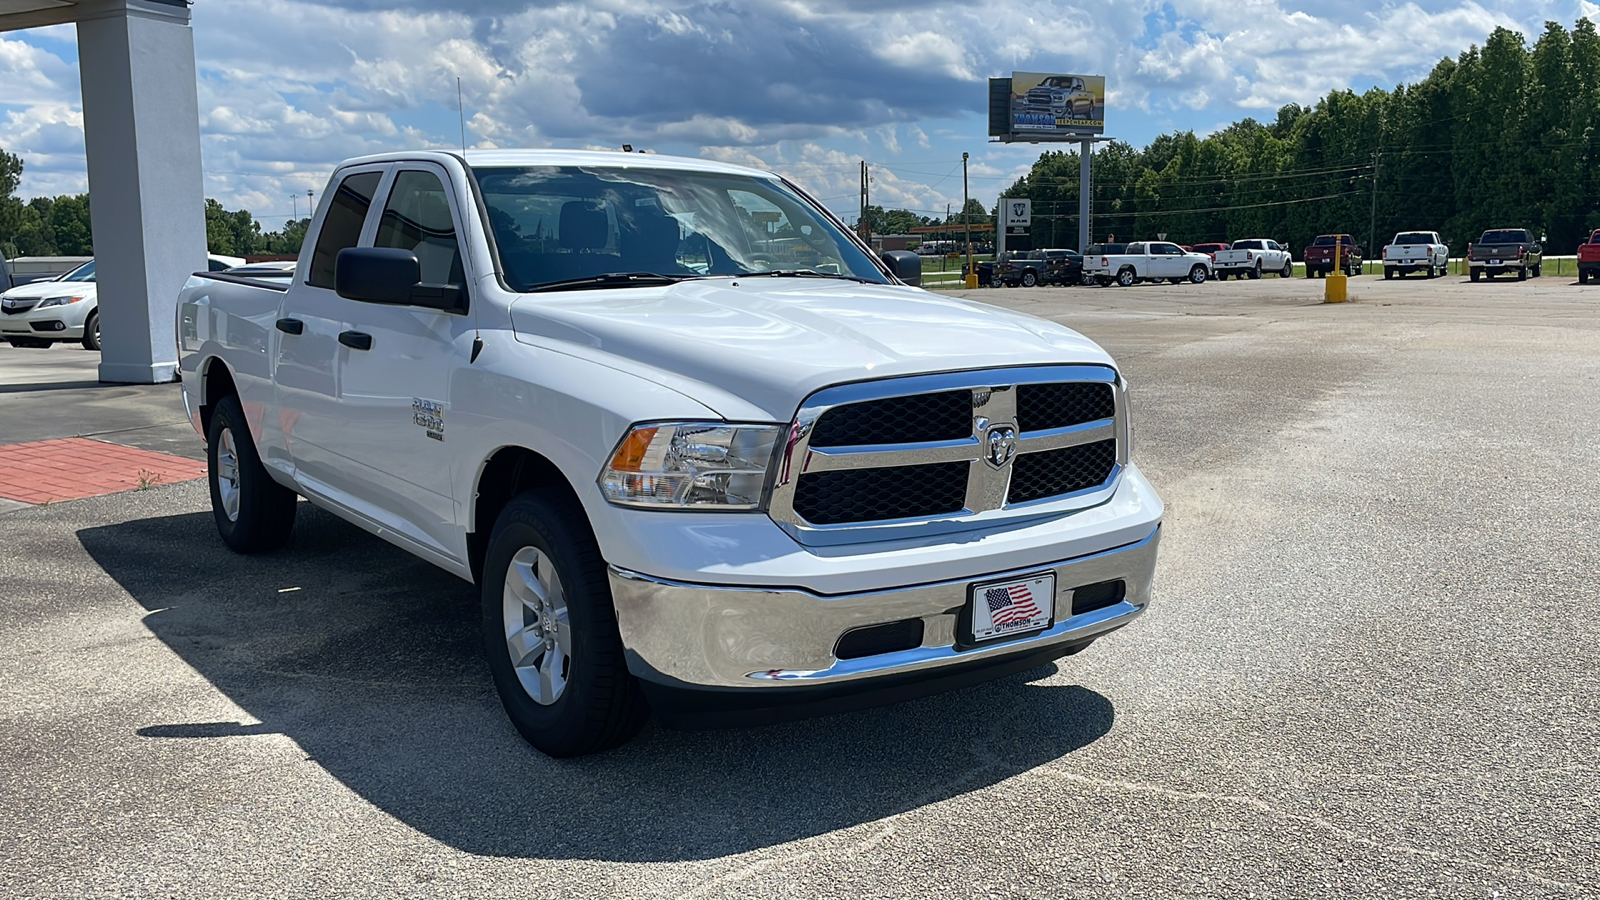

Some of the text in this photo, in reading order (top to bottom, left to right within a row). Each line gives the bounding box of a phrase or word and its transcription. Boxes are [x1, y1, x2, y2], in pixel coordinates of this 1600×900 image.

[1014, 114, 1056, 125] THOMSON
[412, 397, 443, 418] RAM
[413, 411, 444, 433] 1500
[1002, 618, 1031, 629] THOMSON
